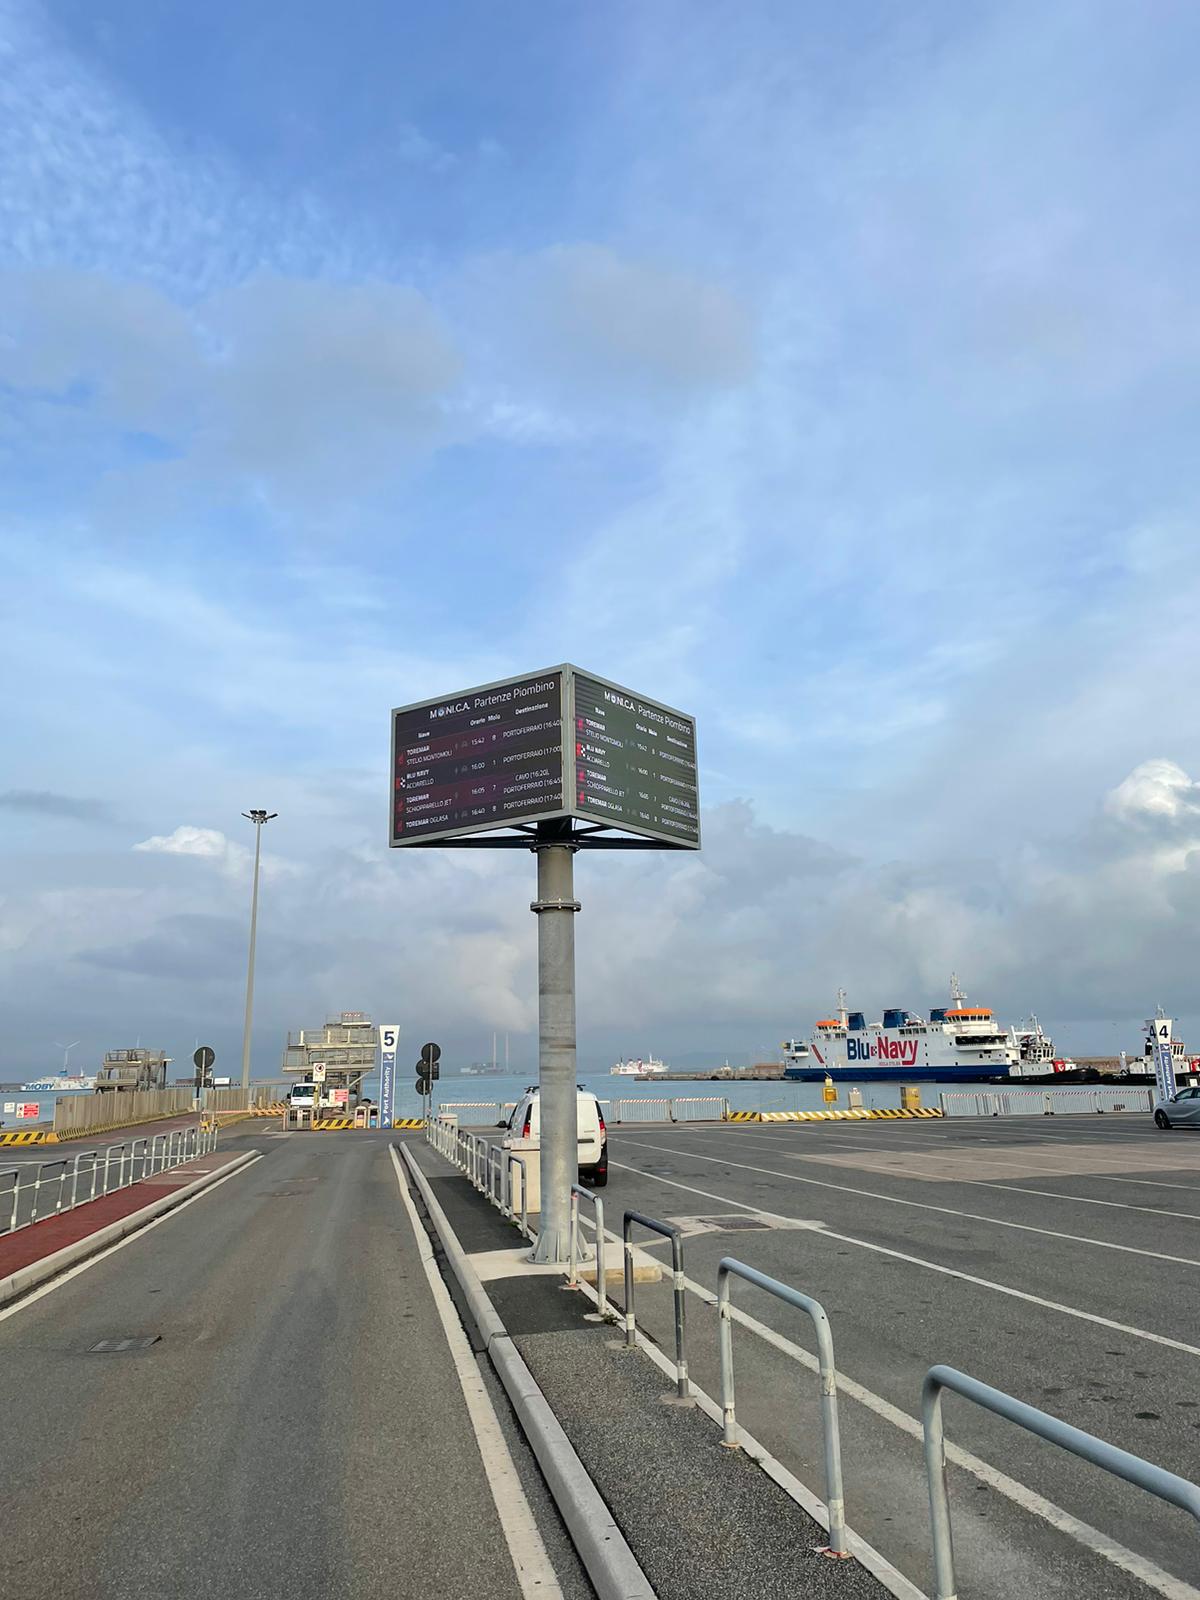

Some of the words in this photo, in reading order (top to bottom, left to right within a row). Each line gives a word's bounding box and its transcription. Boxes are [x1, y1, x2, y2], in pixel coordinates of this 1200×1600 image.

[474, 692, 512, 708] Partenze
[513, 680, 555, 698] Piombino
[515, 702, 549, 715] Destinazione
[470, 717, 486, 726] Orario
[488, 713, 500, 722] Molo
[638, 705, 664, 723] Partenze
[665, 715, 691, 735] Piombino
[503, 723, 542, 738] PORTOFERRAIO
[503, 749, 543, 764] PORTOFERRAIO
[515, 772, 529, 781] CAVO
[504, 780, 543, 794] PORTOFERRAIO
[406, 793, 430, 804] TOREMAR
[504, 796, 543, 810] PORTOFERRAIO
[406, 818, 429, 828] TOREMAR
[1149, 1025, 1156, 1038] 4
[1159, 1025, 1168, 1038] 4
[384, 1031, 394, 1046] 5
[847, 1038, 870, 1060] Blu
[877, 1036, 918, 1065] Navy
